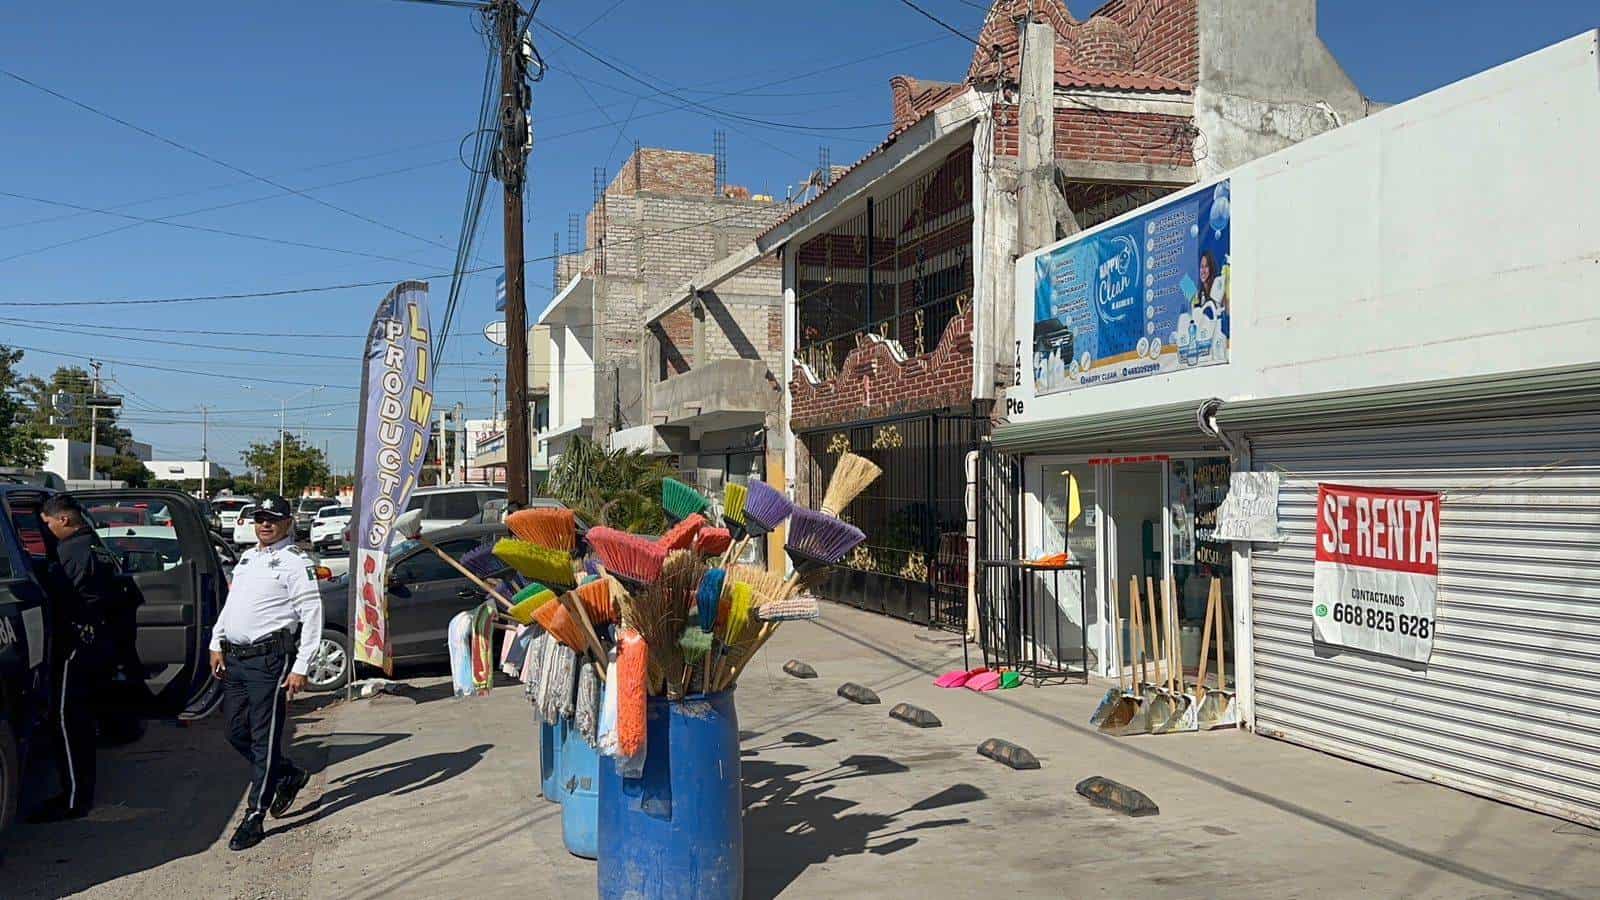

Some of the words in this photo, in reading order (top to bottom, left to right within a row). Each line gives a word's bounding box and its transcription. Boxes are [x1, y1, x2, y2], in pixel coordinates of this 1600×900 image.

[1100, 276, 1130, 304] Clean
[1102, 371, 1117, 381] CLEAN
[398, 302, 432, 506] LIMPI
[1006, 398, 1024, 416] Pte
[369, 319, 403, 546] PRODUCTOS
[1322, 494, 1350, 554] SE
[1356, 496, 1437, 566] RENTA
[1351, 588, 1405, 607] CONTACTANOS
[1333, 602, 1363, 626] 668
[1366, 608, 1395, 633] 825
[1399, 614, 1436, 639] 6281
